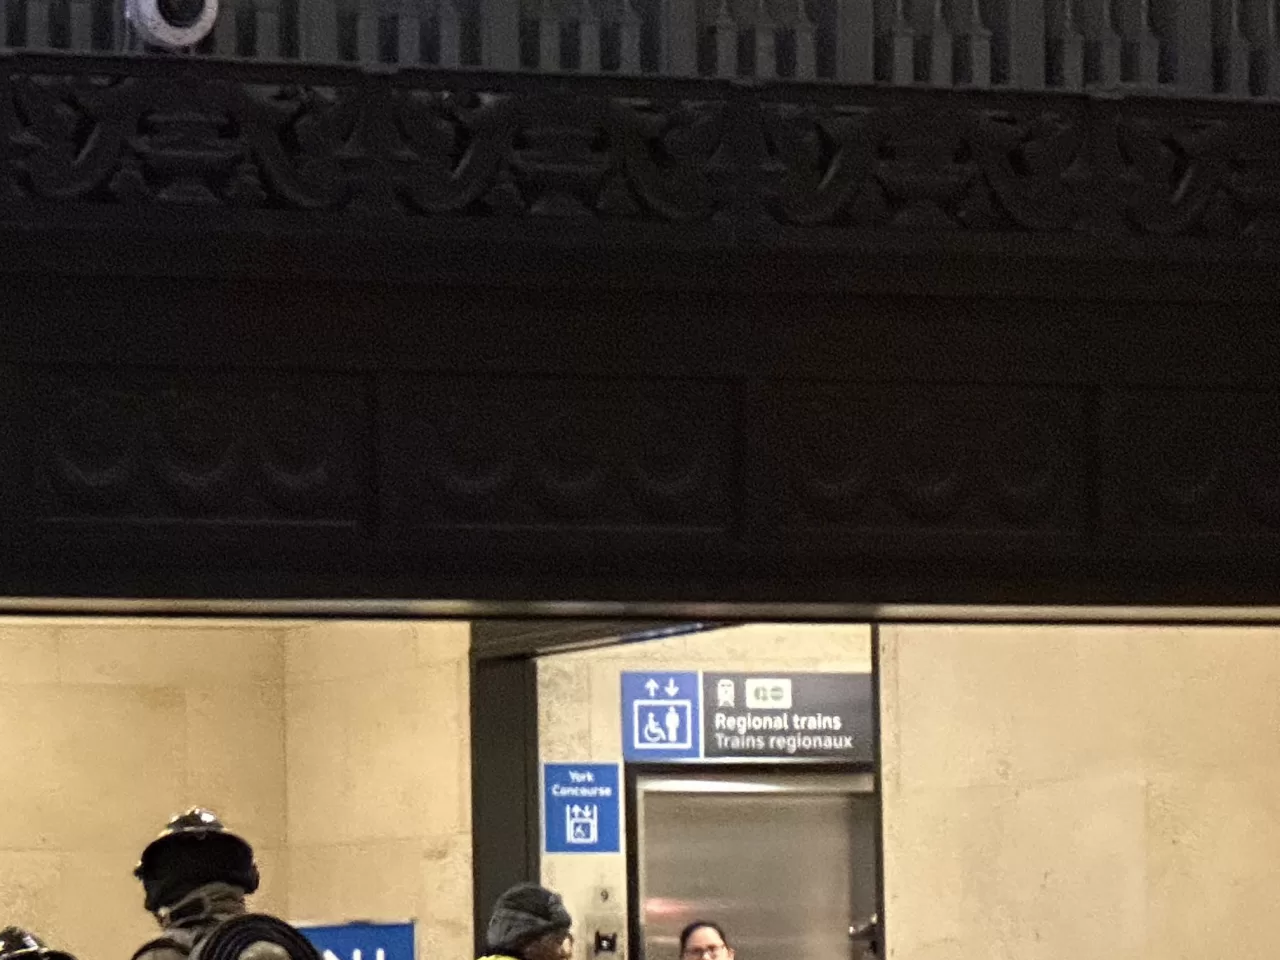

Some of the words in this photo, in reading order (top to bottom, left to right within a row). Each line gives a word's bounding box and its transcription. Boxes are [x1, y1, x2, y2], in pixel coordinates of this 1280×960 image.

[715, 712, 789, 735] Regional
[793, 712, 842, 731] trains
[715, 732, 765, 749] Trains
[770, 732, 854, 753] regionaux
[568, 769, 595, 783] York
[551, 783, 613, 797] Concourse
